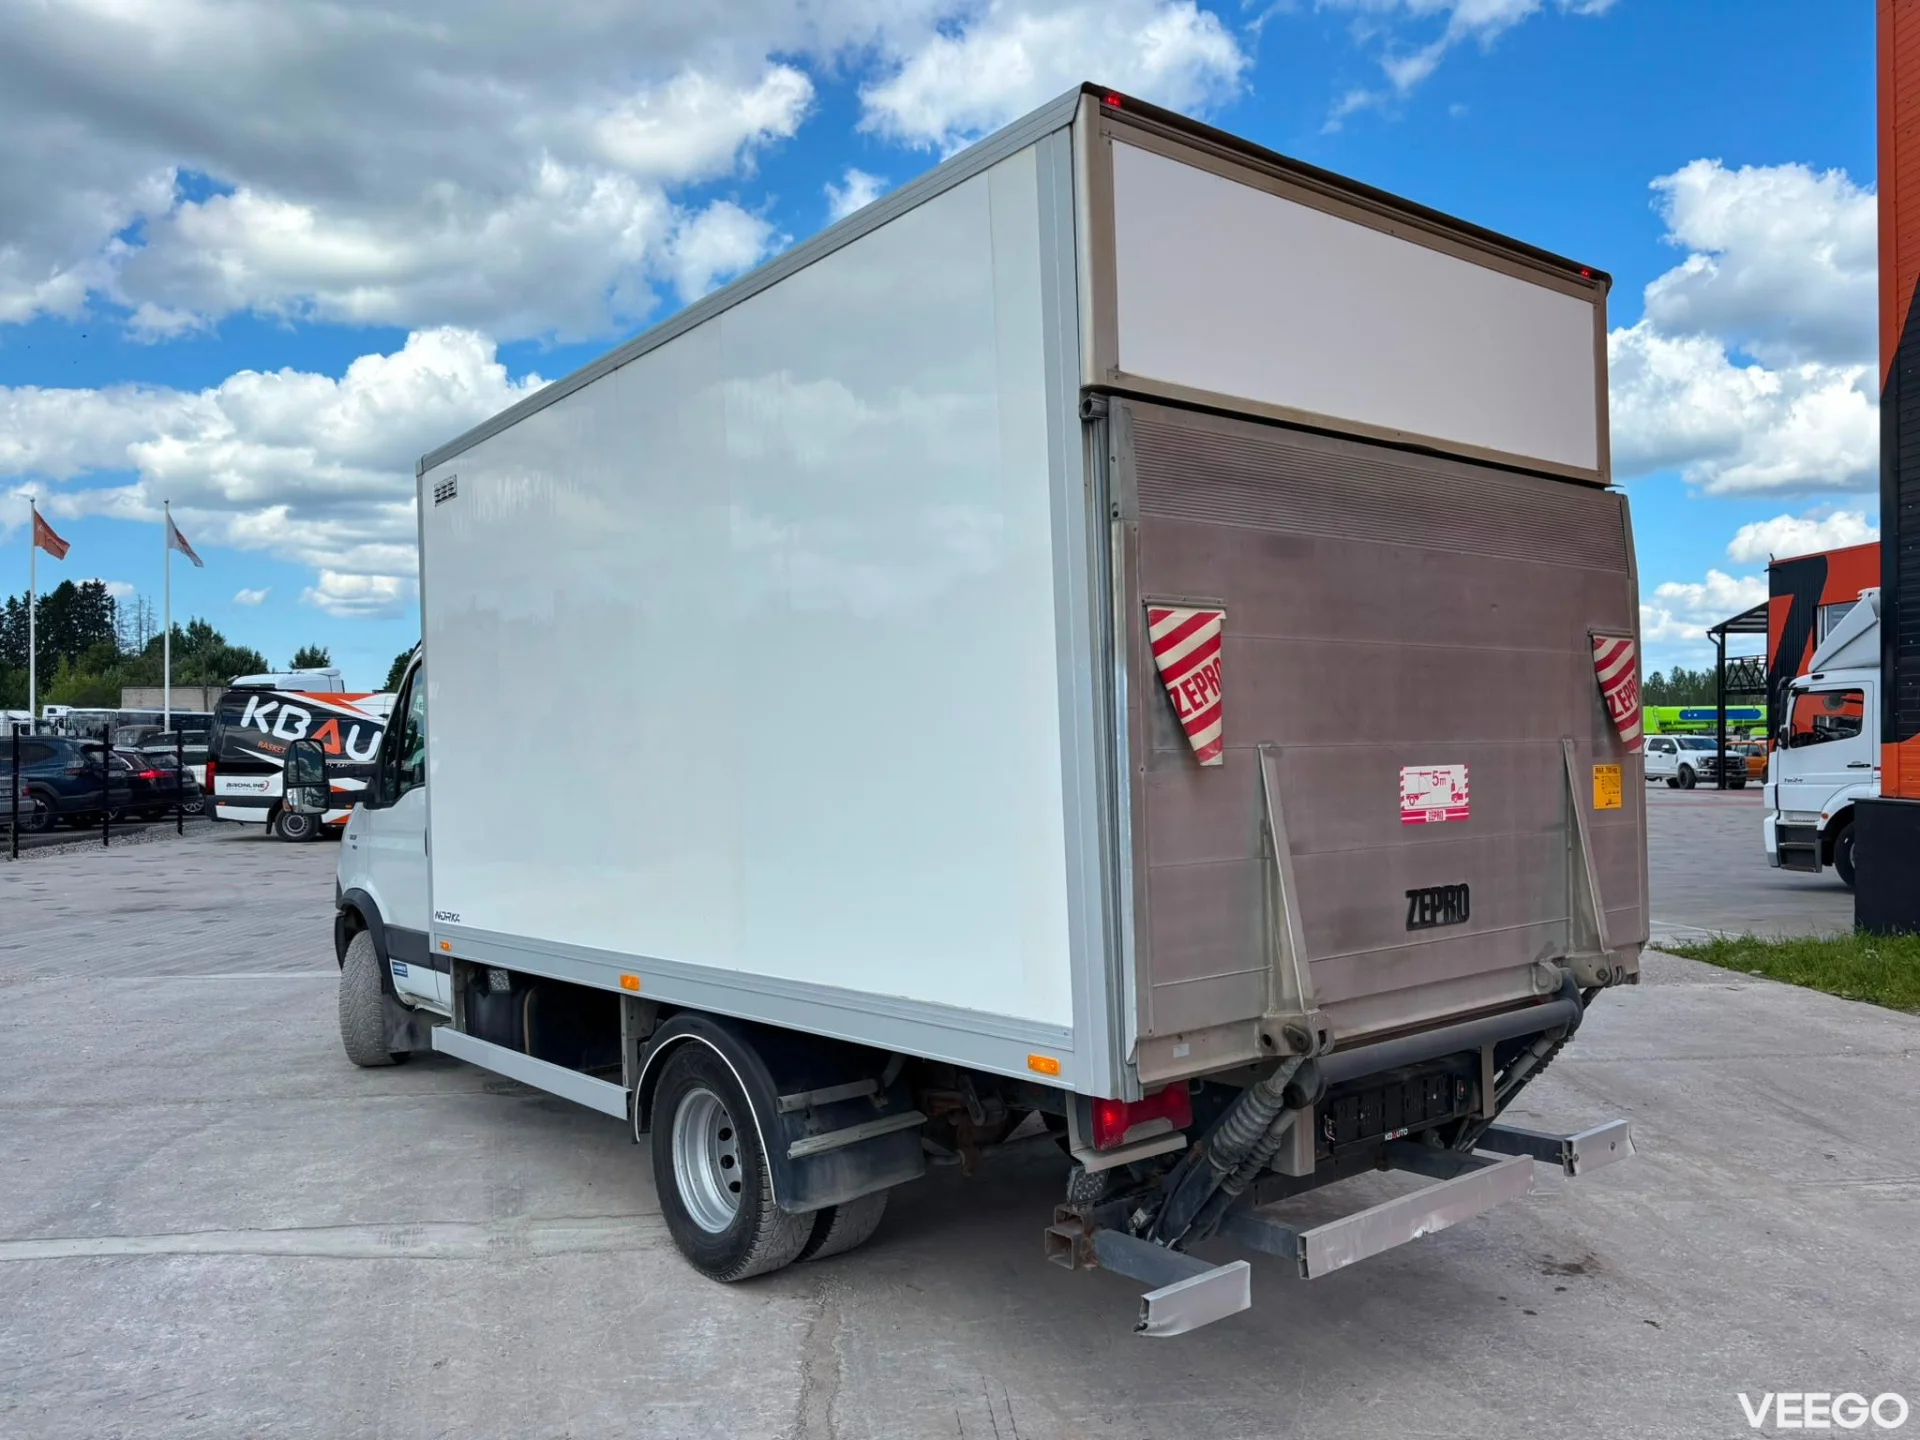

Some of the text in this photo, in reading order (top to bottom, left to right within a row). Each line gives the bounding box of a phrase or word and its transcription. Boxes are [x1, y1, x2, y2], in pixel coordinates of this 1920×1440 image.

[1607, 674, 1638, 718] ZEPR
[1428, 810, 1444, 821] ZEPRO
[434, 910, 461, 923] NORKA
[1405, 883, 1470, 932] ZEPRO
